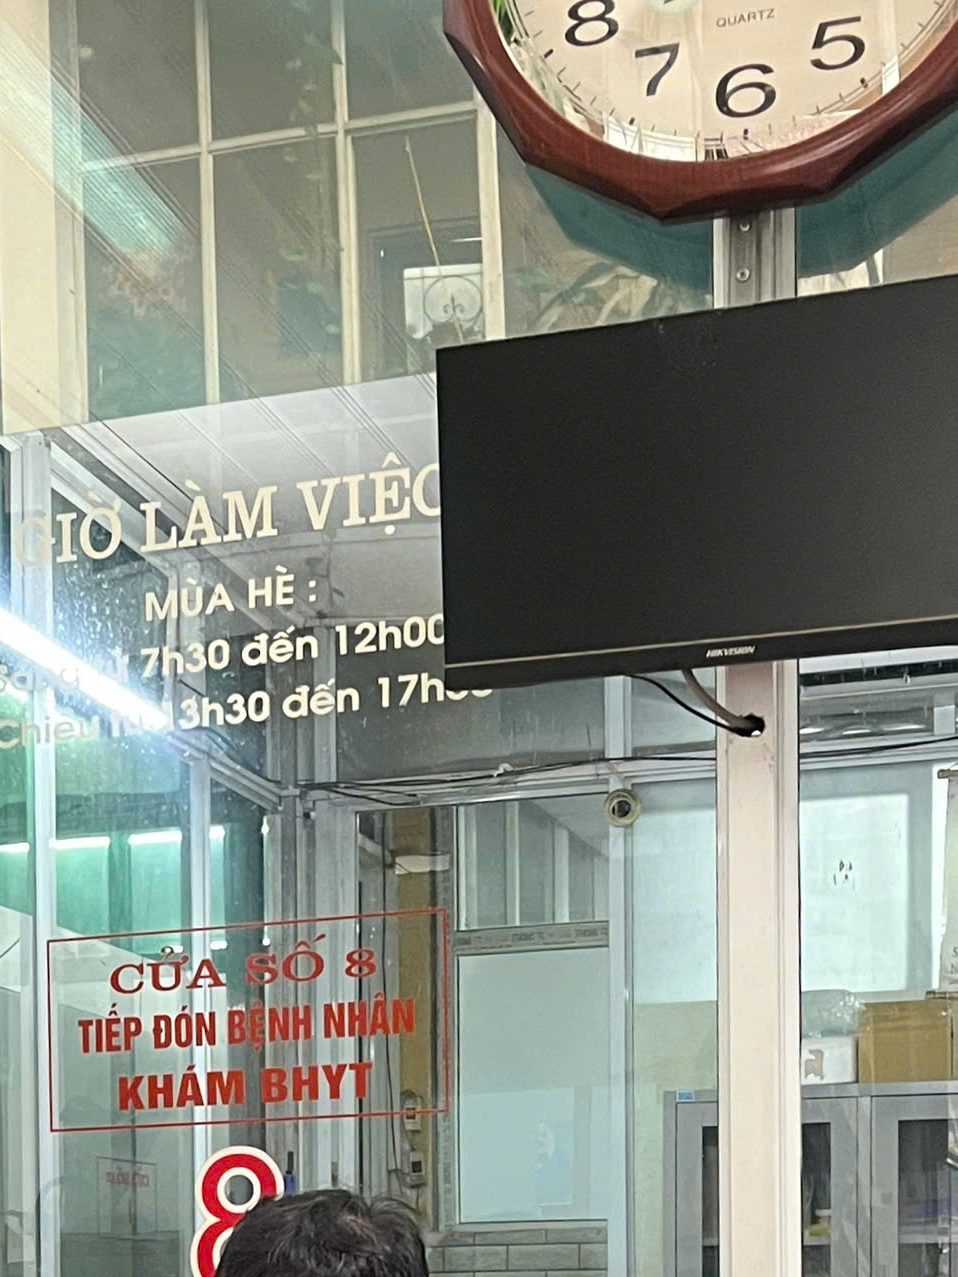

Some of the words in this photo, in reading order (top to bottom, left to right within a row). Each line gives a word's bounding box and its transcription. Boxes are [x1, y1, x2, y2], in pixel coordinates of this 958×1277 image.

[564, 0, 619, 47] 8
[716, 8, 776, 28] QUARTZ
[810, 16, 866, 71] 5
[635, 42, 681, 97] 7
[715, 63, 777, 118] 6
[141, 480, 278, 553] LÀM
[297, 453, 441, 536] VIỆC
[145, 580, 234, 622] MÙA
[248, 566, 295, 609] HÈ
[141, 639, 230, 678] 7h30
[242, 630, 319, 665] đến
[336, 615, 444, 655] 12h00
[283, 684, 359, 718] đến
[378, 671, 492, 708] 17h
[110, 945, 227, 994] CỬA
[245, 934, 326, 985] SỐ
[345, 949, 378, 978] 8
[78, 1002, 143, 1054] TIẾP
[153, 1004, 217, 1050] ĐÓN
[227, 999, 312, 1054] BỆNH
[323, 992, 417, 1038] NHÂN
[118, 1064, 247, 1111] KHÁM
[260, 1062, 373, 1103] BHYT
